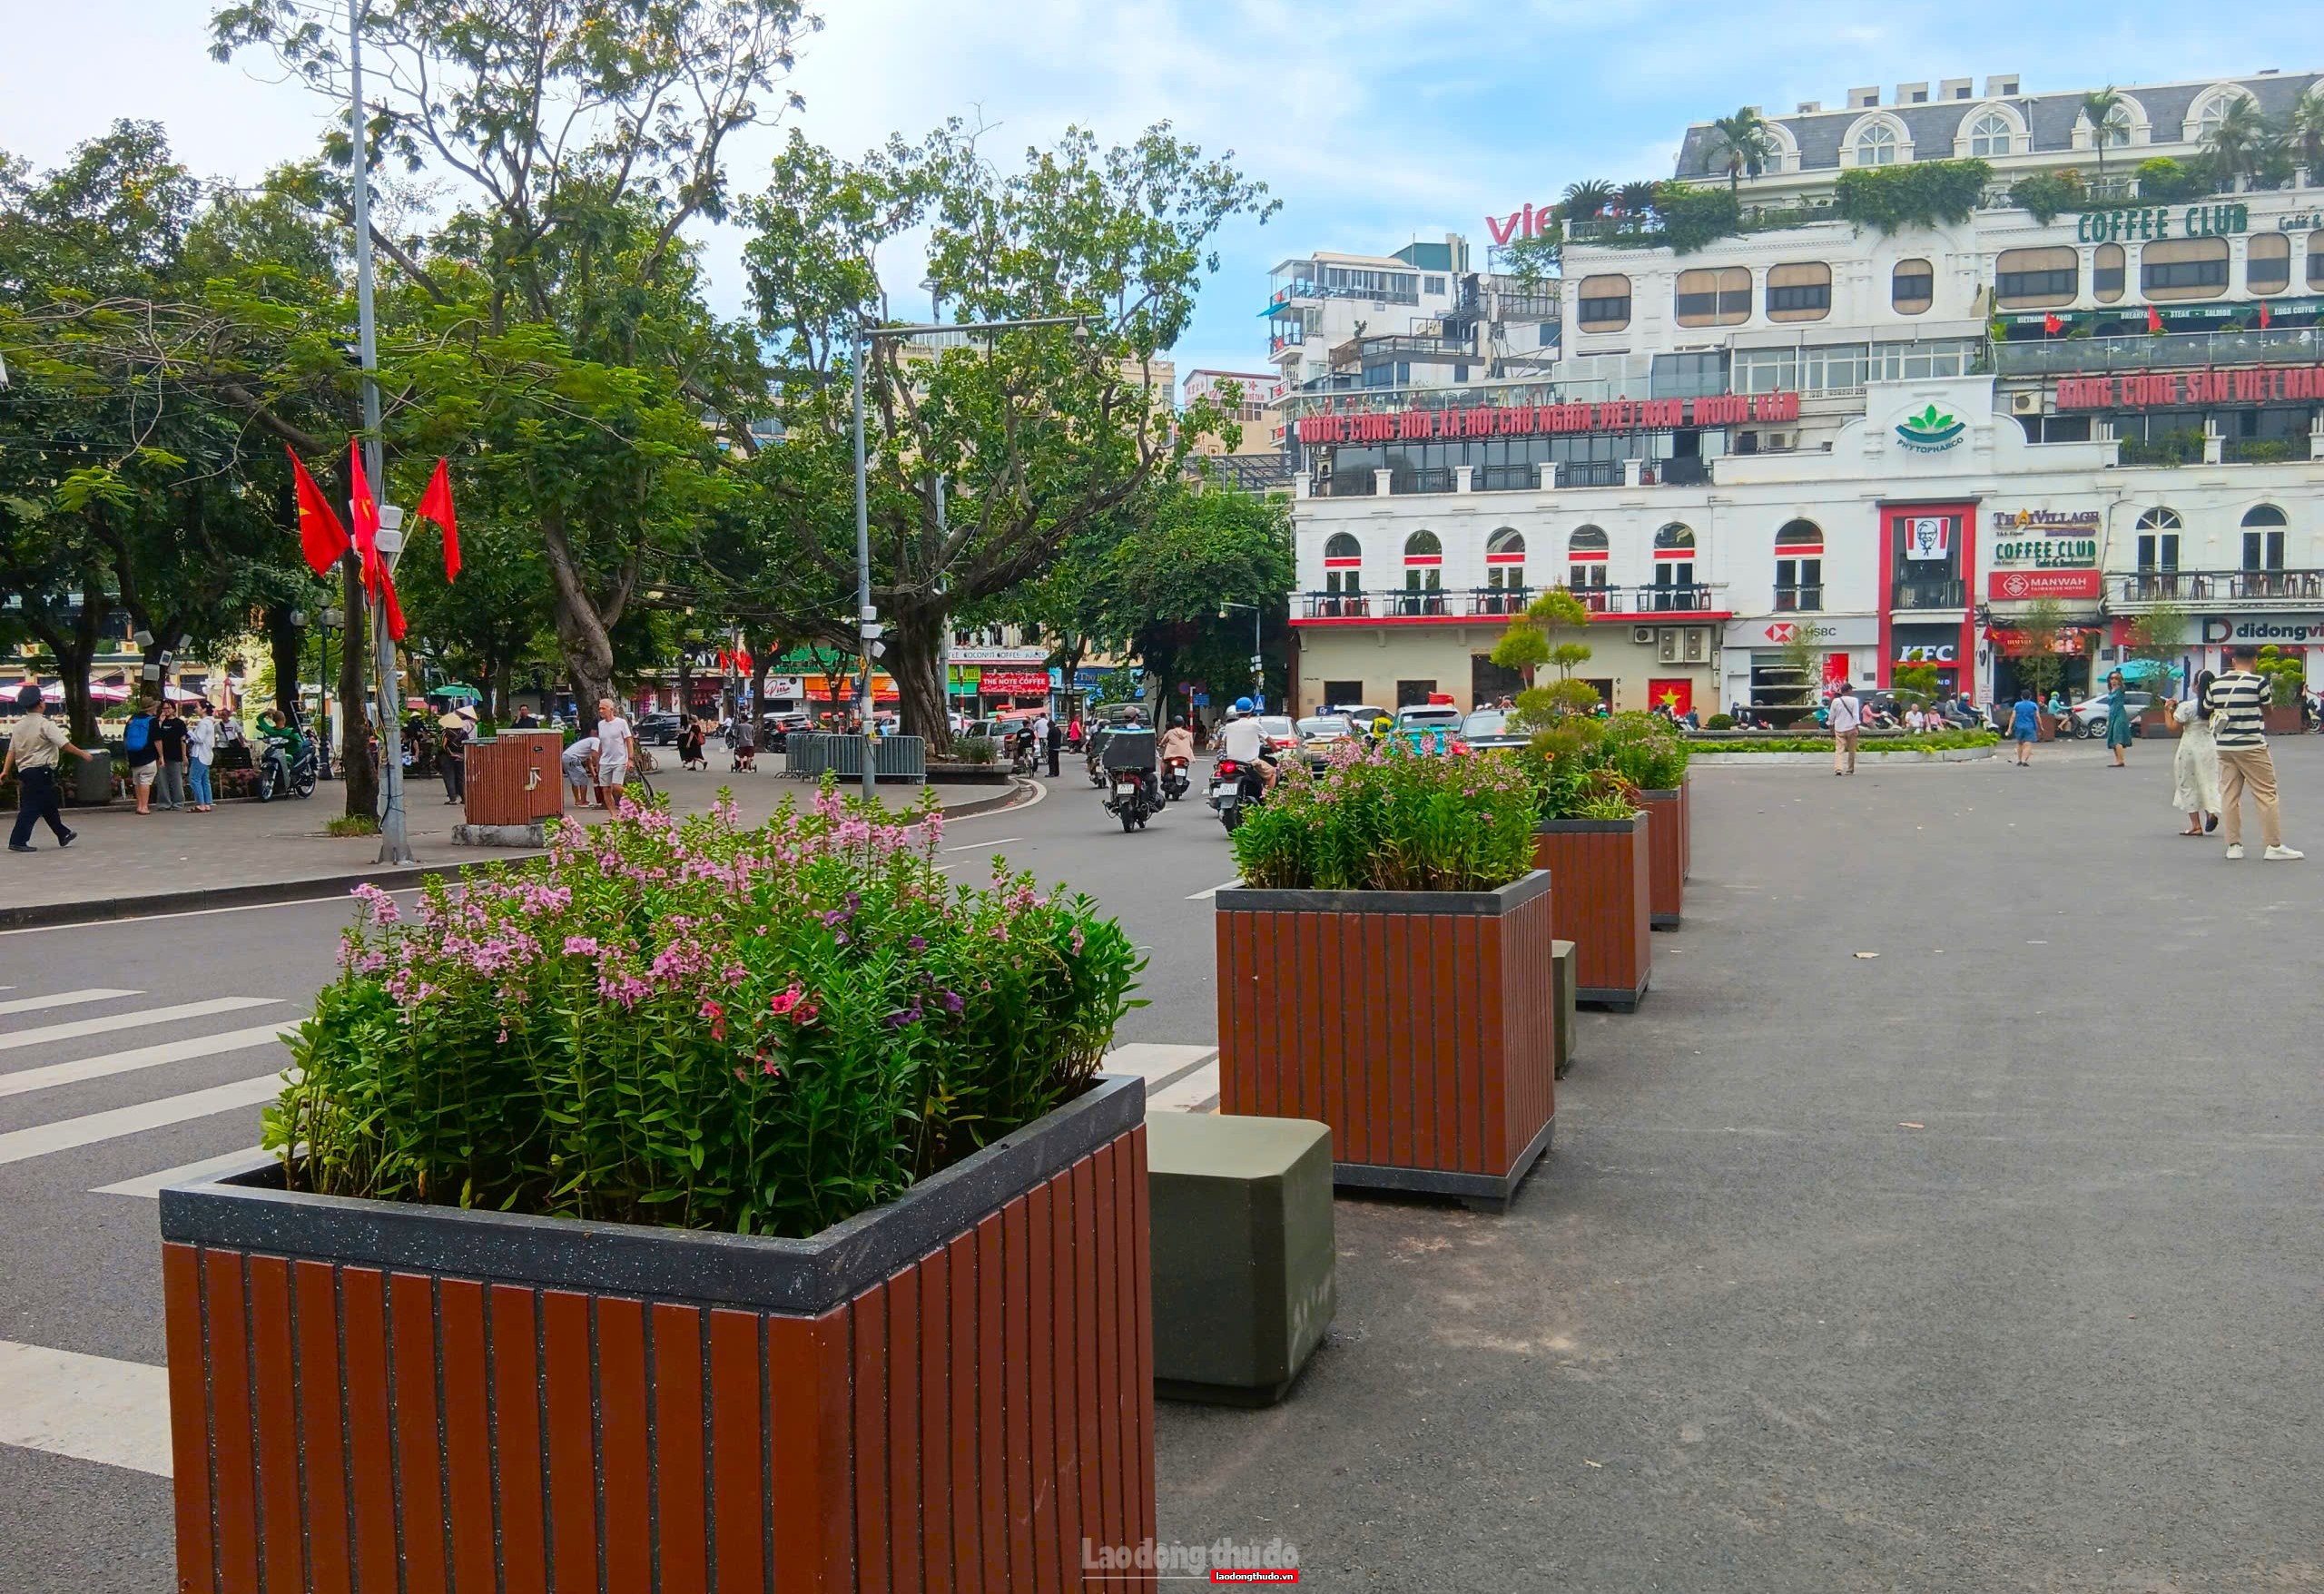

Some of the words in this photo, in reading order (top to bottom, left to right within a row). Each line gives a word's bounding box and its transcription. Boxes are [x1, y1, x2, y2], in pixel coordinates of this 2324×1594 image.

[2079, 209, 2168, 242] COFFEE
[2186, 203, 2249, 237] CLUB
[2121, 310, 2150, 320] BREAKFA
[2292, 305, 2317, 314] COFFEE
[2122, 368, 2177, 410] CỘNG
[2234, 363, 2280, 406] VIỆT
[1350, 408, 1394, 447] CỘNG
[1599, 394, 1639, 436] VIỆT
[1641, 398, 1683, 428] NAM
[1693, 387, 1749, 427] MUÔN
[1756, 386, 1799, 422] NĂM
[1896, 437, 1964, 454] PHYTOPHARCO
[1995, 541, 2052, 559] COFFEE
[2031, 577, 2086, 586] MANWAH
[1806, 627, 1837, 636] HSBC
[1899, 645, 1955, 662] KFC
